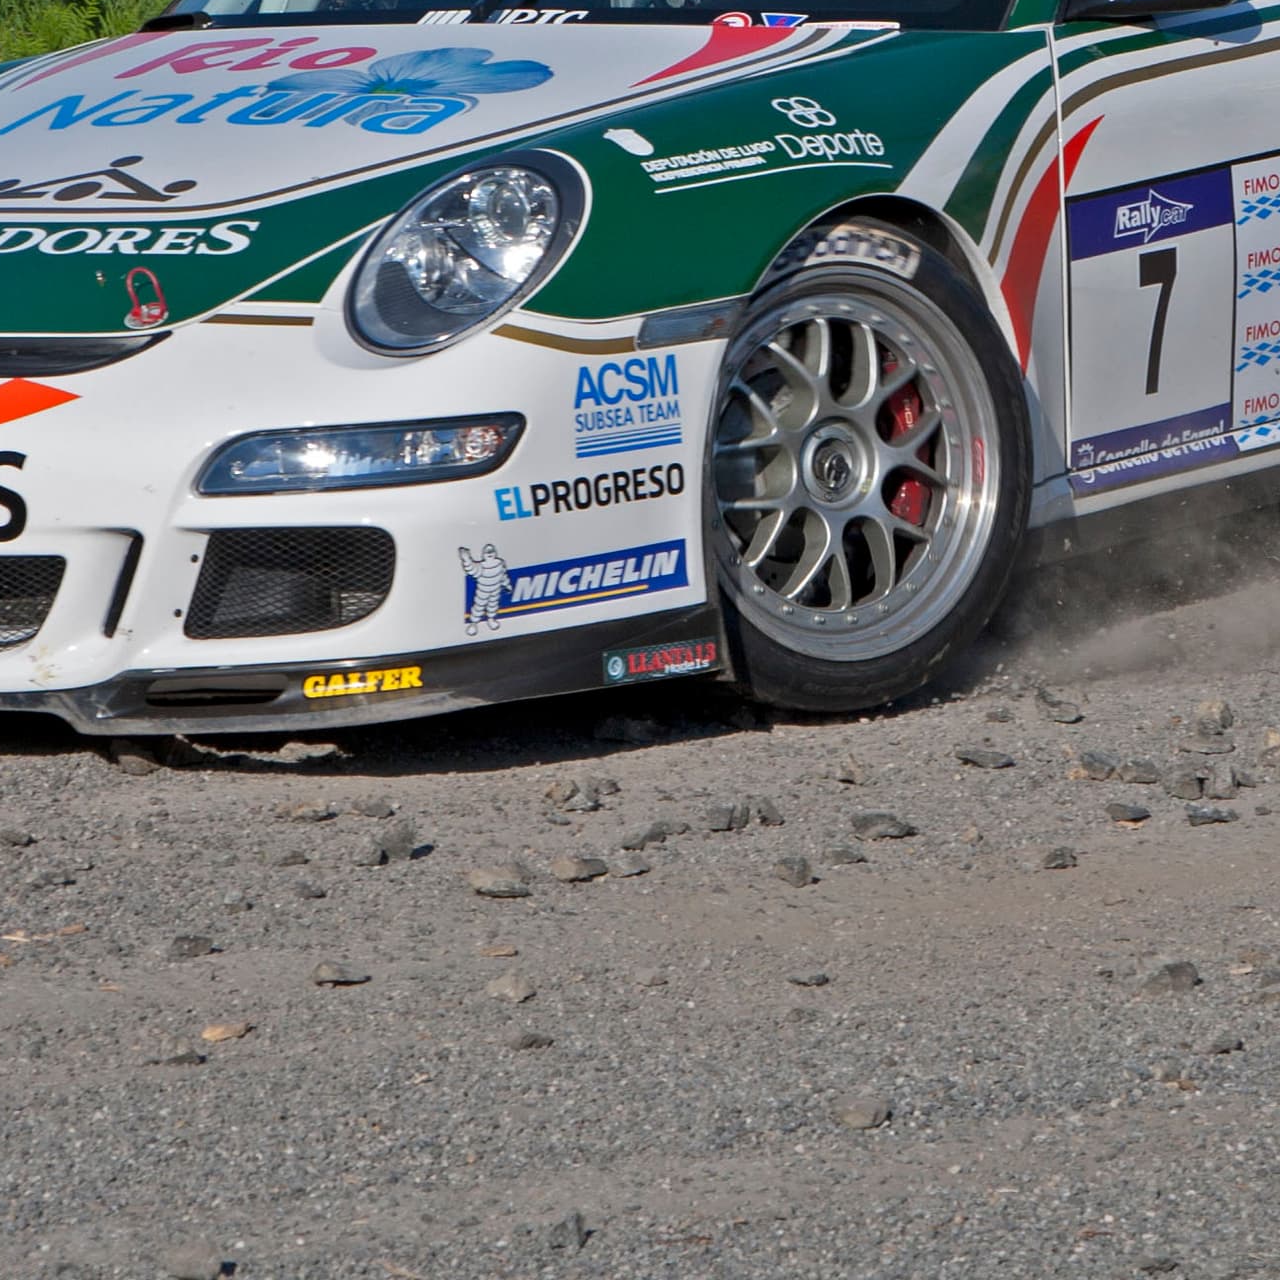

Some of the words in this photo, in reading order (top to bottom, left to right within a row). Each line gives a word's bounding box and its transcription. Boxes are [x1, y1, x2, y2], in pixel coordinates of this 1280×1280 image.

[114, 36, 377, 80] Rio
[720, 146, 743, 161] DE
[740, 140, 776, 157] LUGO
[1244, 173, 1280, 196] FIMO
[1139, 247, 1177, 396] 7
[1245, 320, 1280, 342] FIMO
[574, 354, 679, 410] ACSM
[575, 407, 635, 433] SUBSEA
[637, 400, 681, 424] TEAM
[1244, 393, 1280, 415] FIMO
[511, 549, 680, 603] MICHELIN
[302, 666, 424, 699] GALFER
